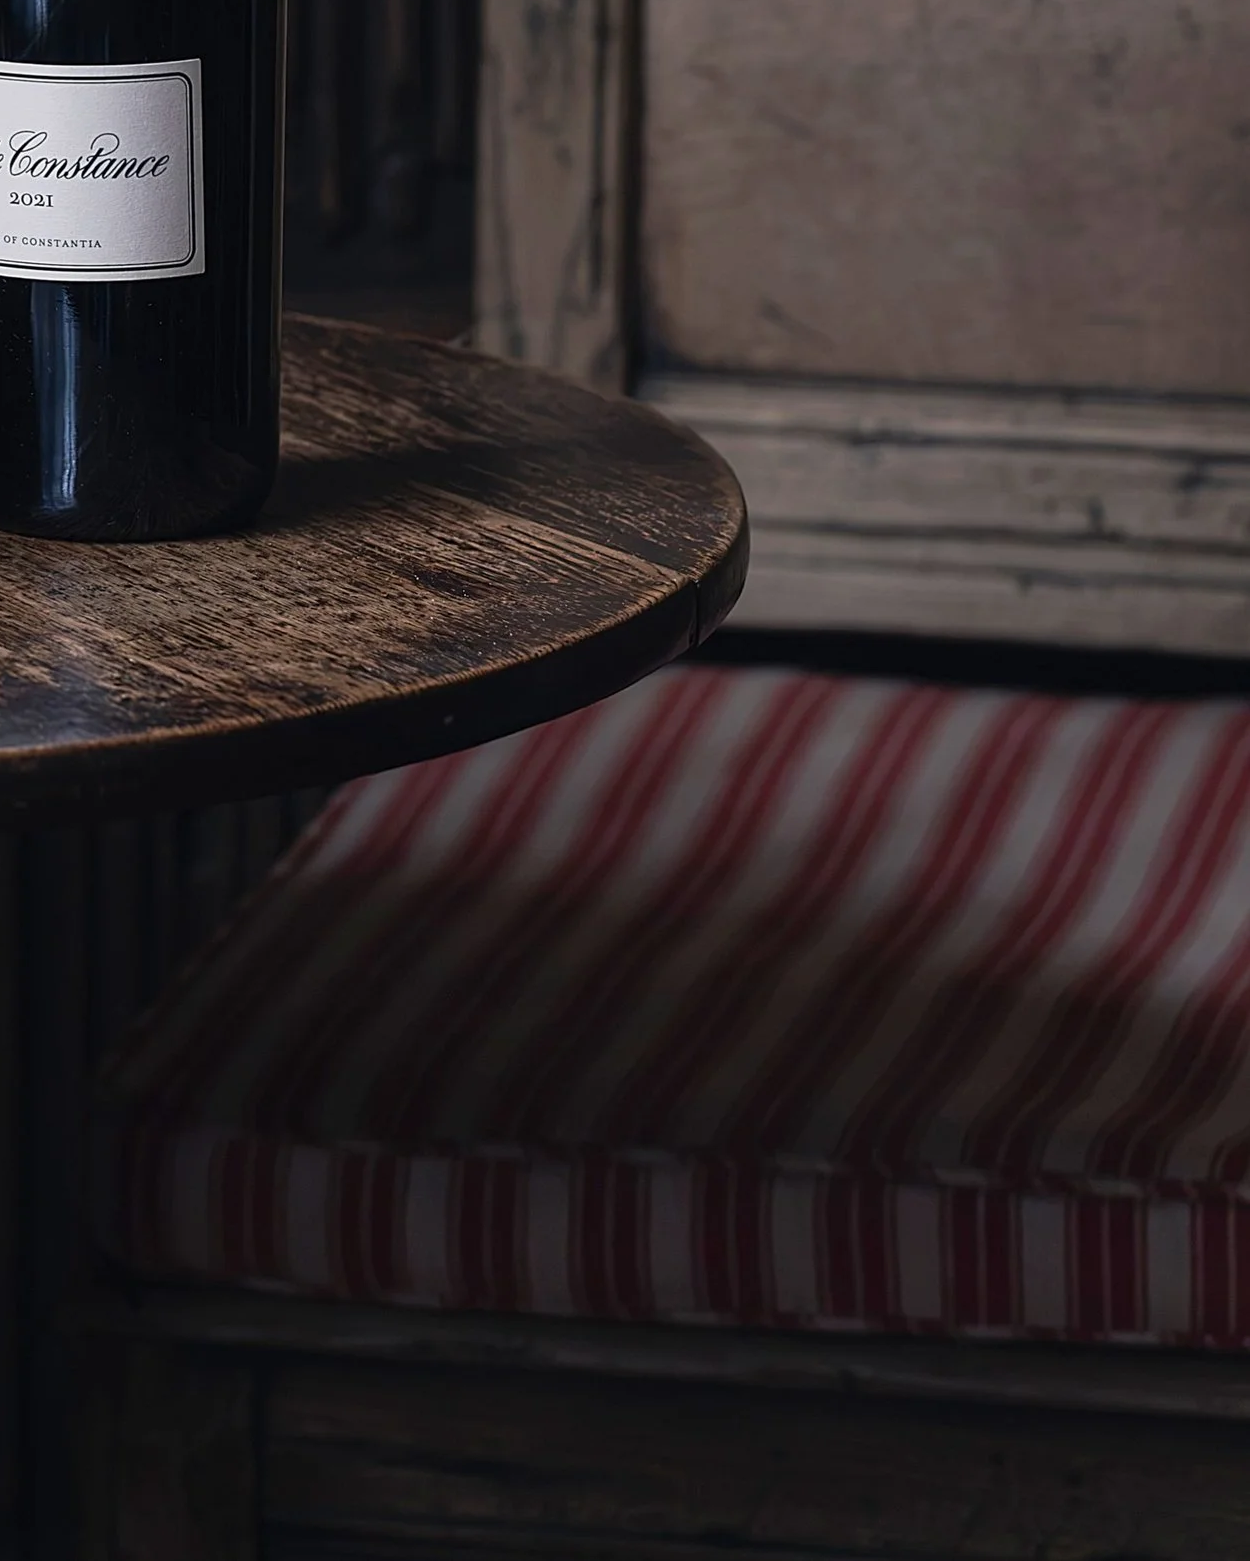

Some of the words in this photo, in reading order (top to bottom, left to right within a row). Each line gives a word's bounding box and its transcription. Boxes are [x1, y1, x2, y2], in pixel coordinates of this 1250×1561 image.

[8, 130, 170, 180] Constance
[9, 191, 54, 208] 2021
[3, 234, 18, 245] OF
[21, 236, 102, 249] CONSTANTIA
